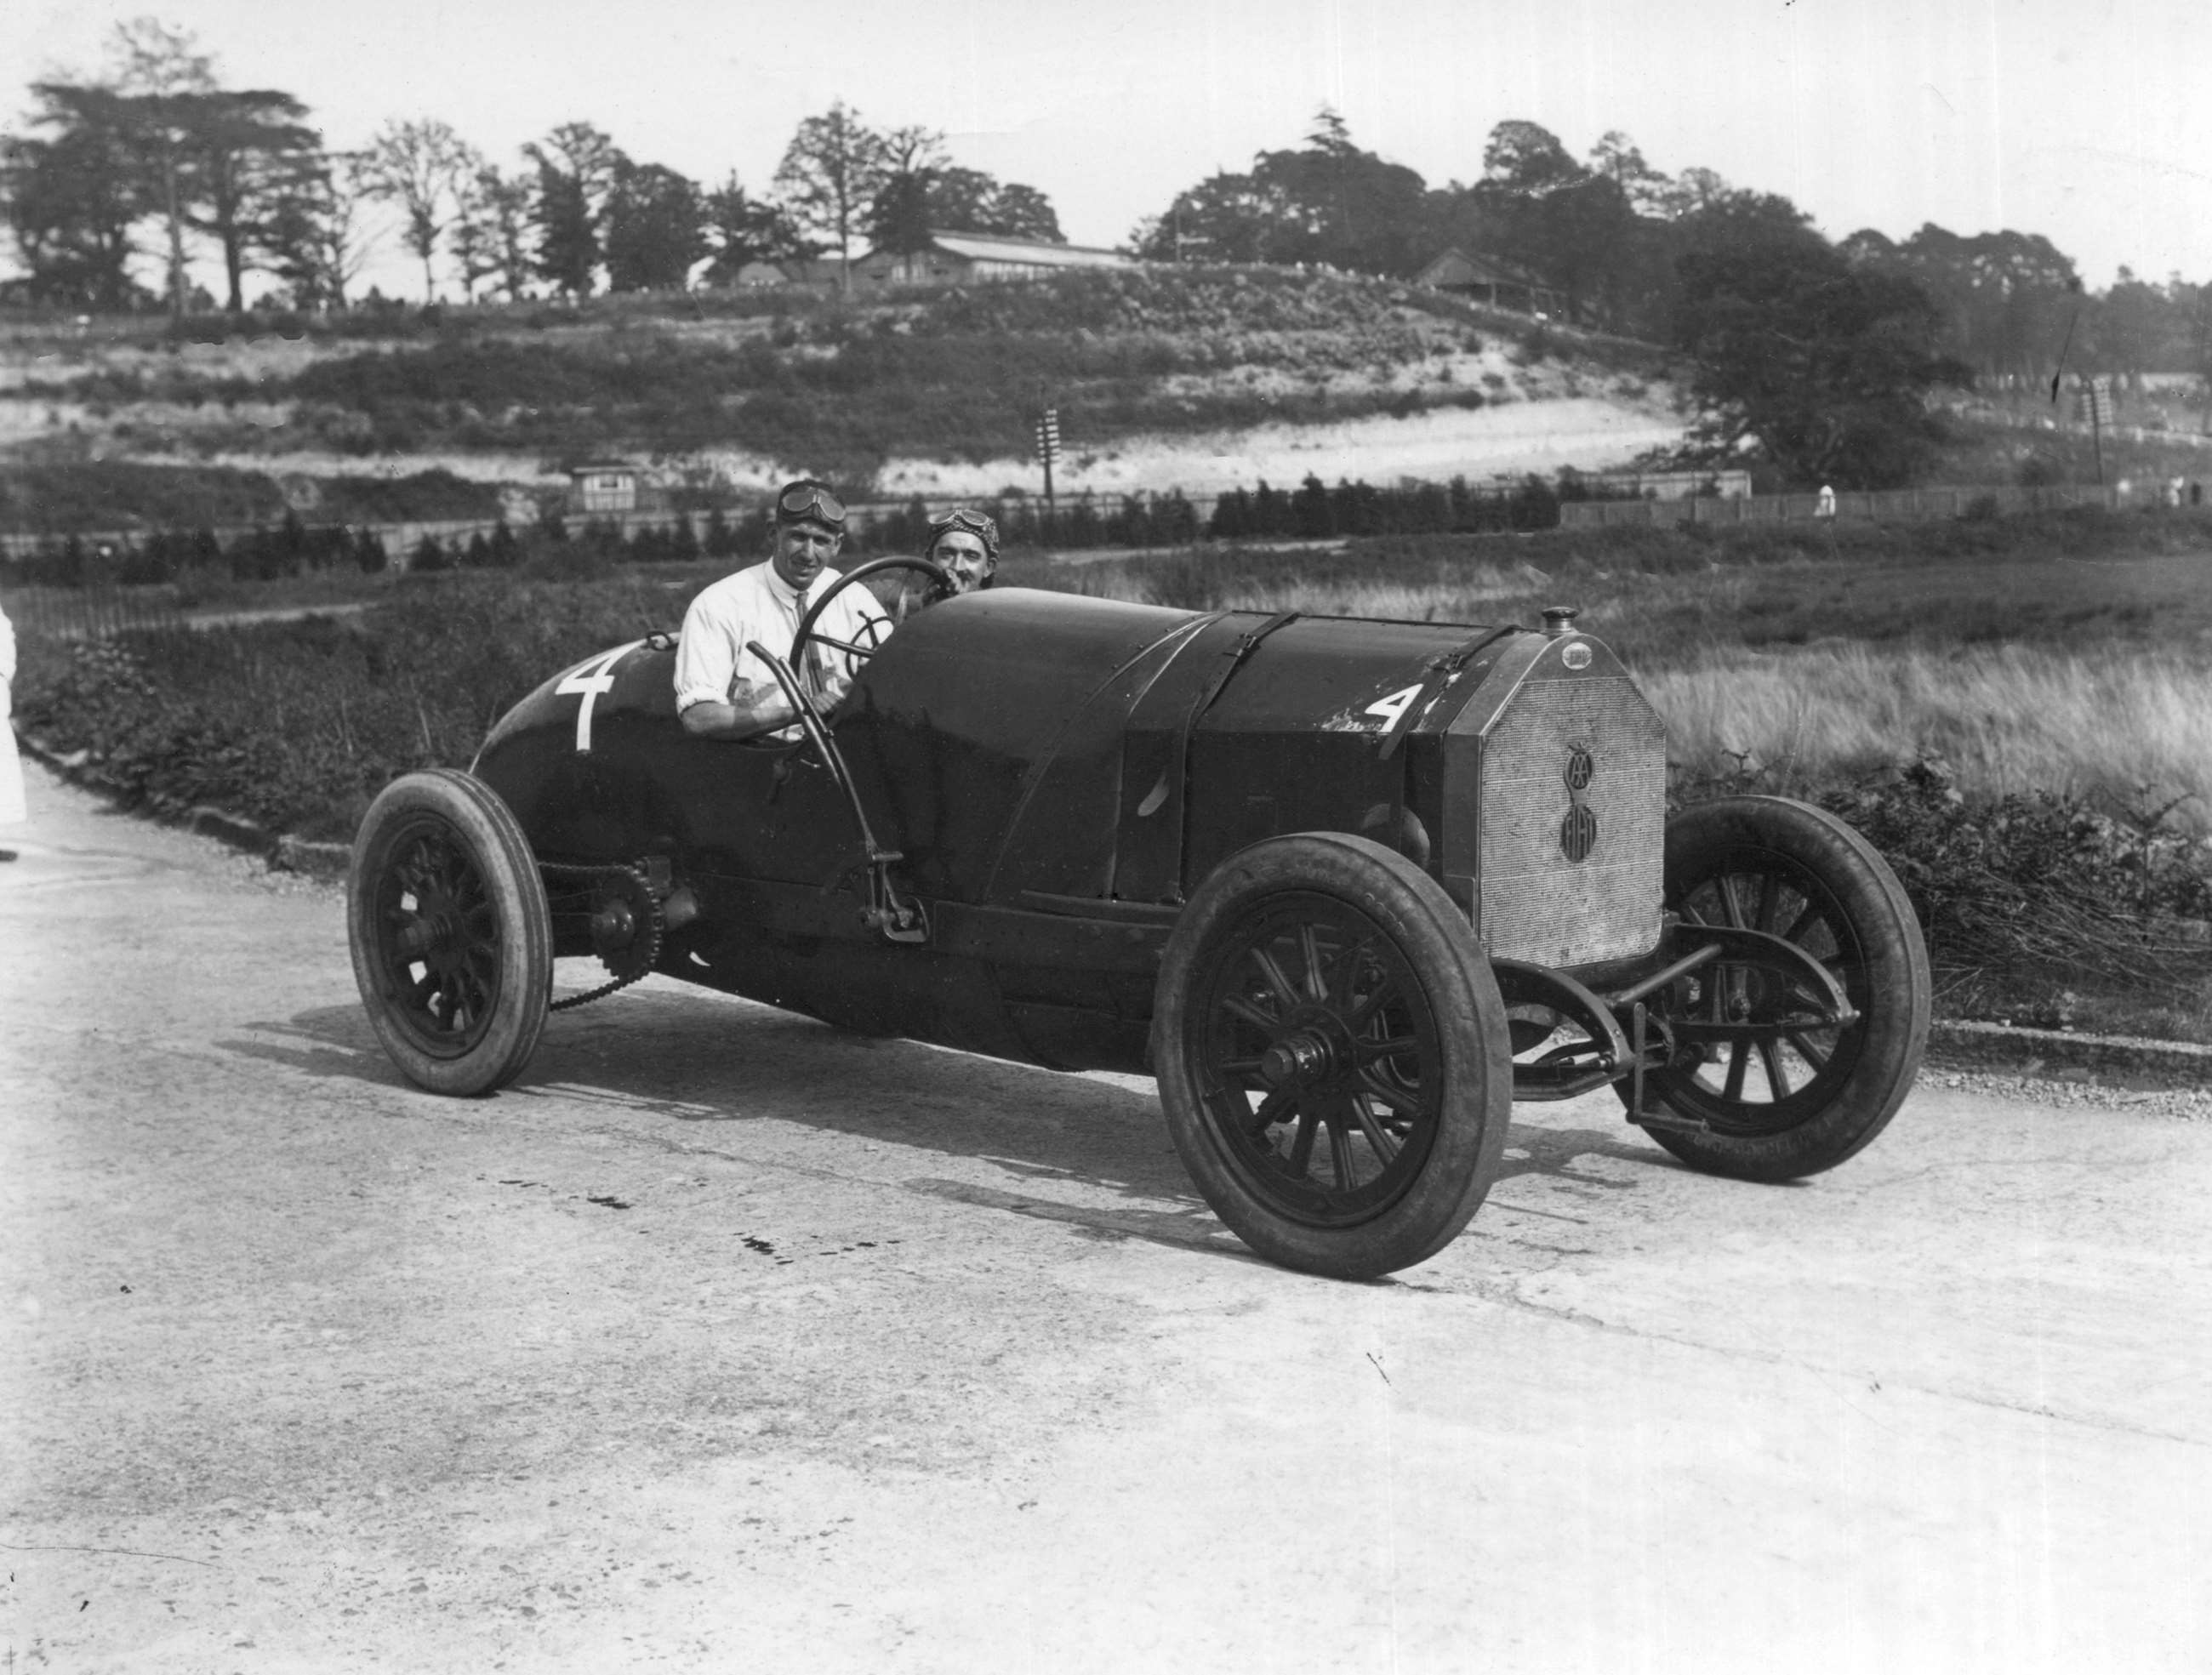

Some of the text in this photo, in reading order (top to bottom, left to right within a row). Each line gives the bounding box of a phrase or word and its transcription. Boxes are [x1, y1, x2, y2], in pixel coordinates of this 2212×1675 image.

[555, 638, 647, 751] 4
[1364, 683, 1424, 733] 4
[1565, 806, 1593, 860] FIAT
